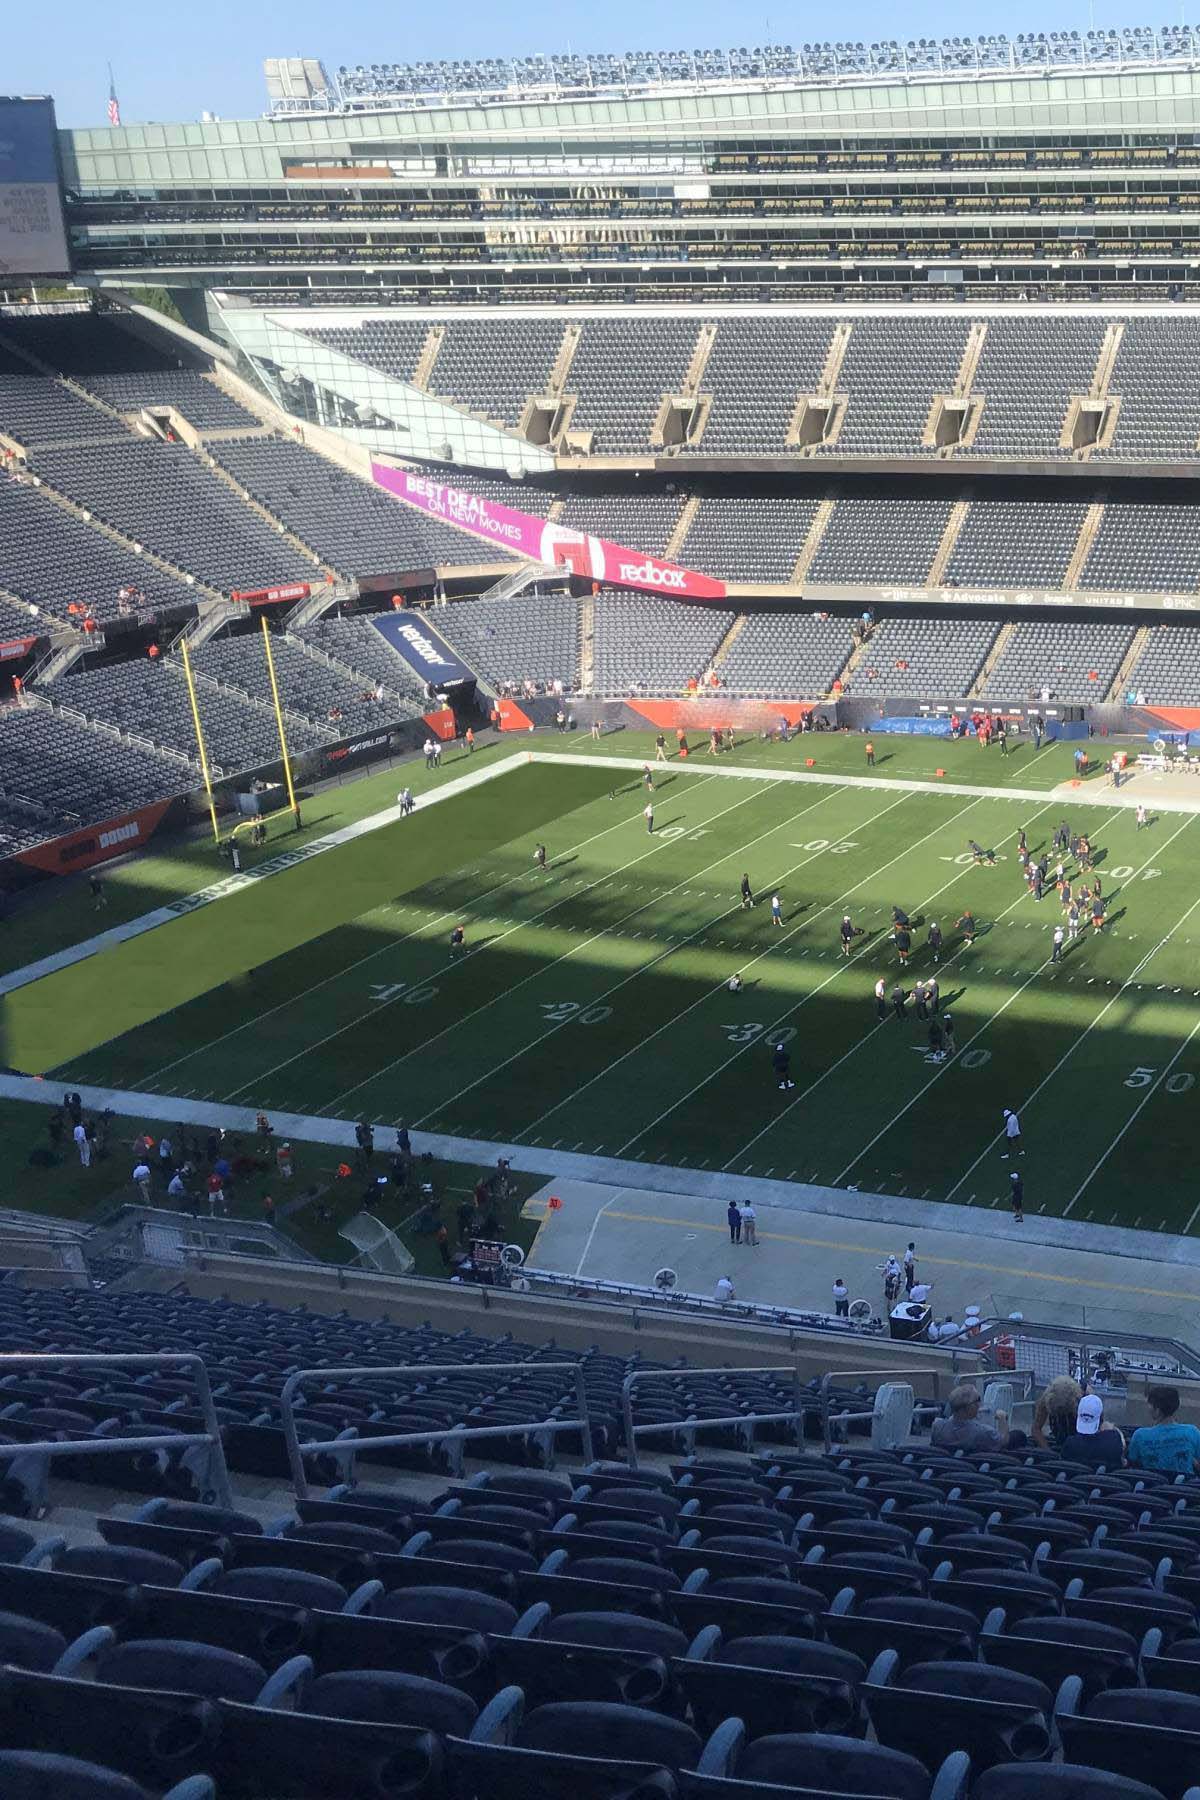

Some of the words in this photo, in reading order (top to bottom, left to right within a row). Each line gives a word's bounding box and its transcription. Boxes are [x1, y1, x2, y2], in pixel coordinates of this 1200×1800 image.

[406, 475, 445, 501] BEST
[447, 487, 488, 517] DEAL
[428, 498, 445, 513] ON
[449, 508, 476, 524] NEW
[479, 517, 522, 541] MOVIES
[618, 560, 687, 588] redbox
[953, 591, 1006, 603] Advocate
[1084, 596, 1123, 606] UNITED
[1173, 597, 1196, 609] PNC
[397, 624, 447, 665] verizon
[803, 840, 859, 854] 20
[1110, 866, 1162, 881] 40
[368, 983, 440, 1003] 10
[543, 1002, 614, 1024] 20
[728, 1022, 798, 1046] 30
[1123, 1066, 1196, 1092] 50
